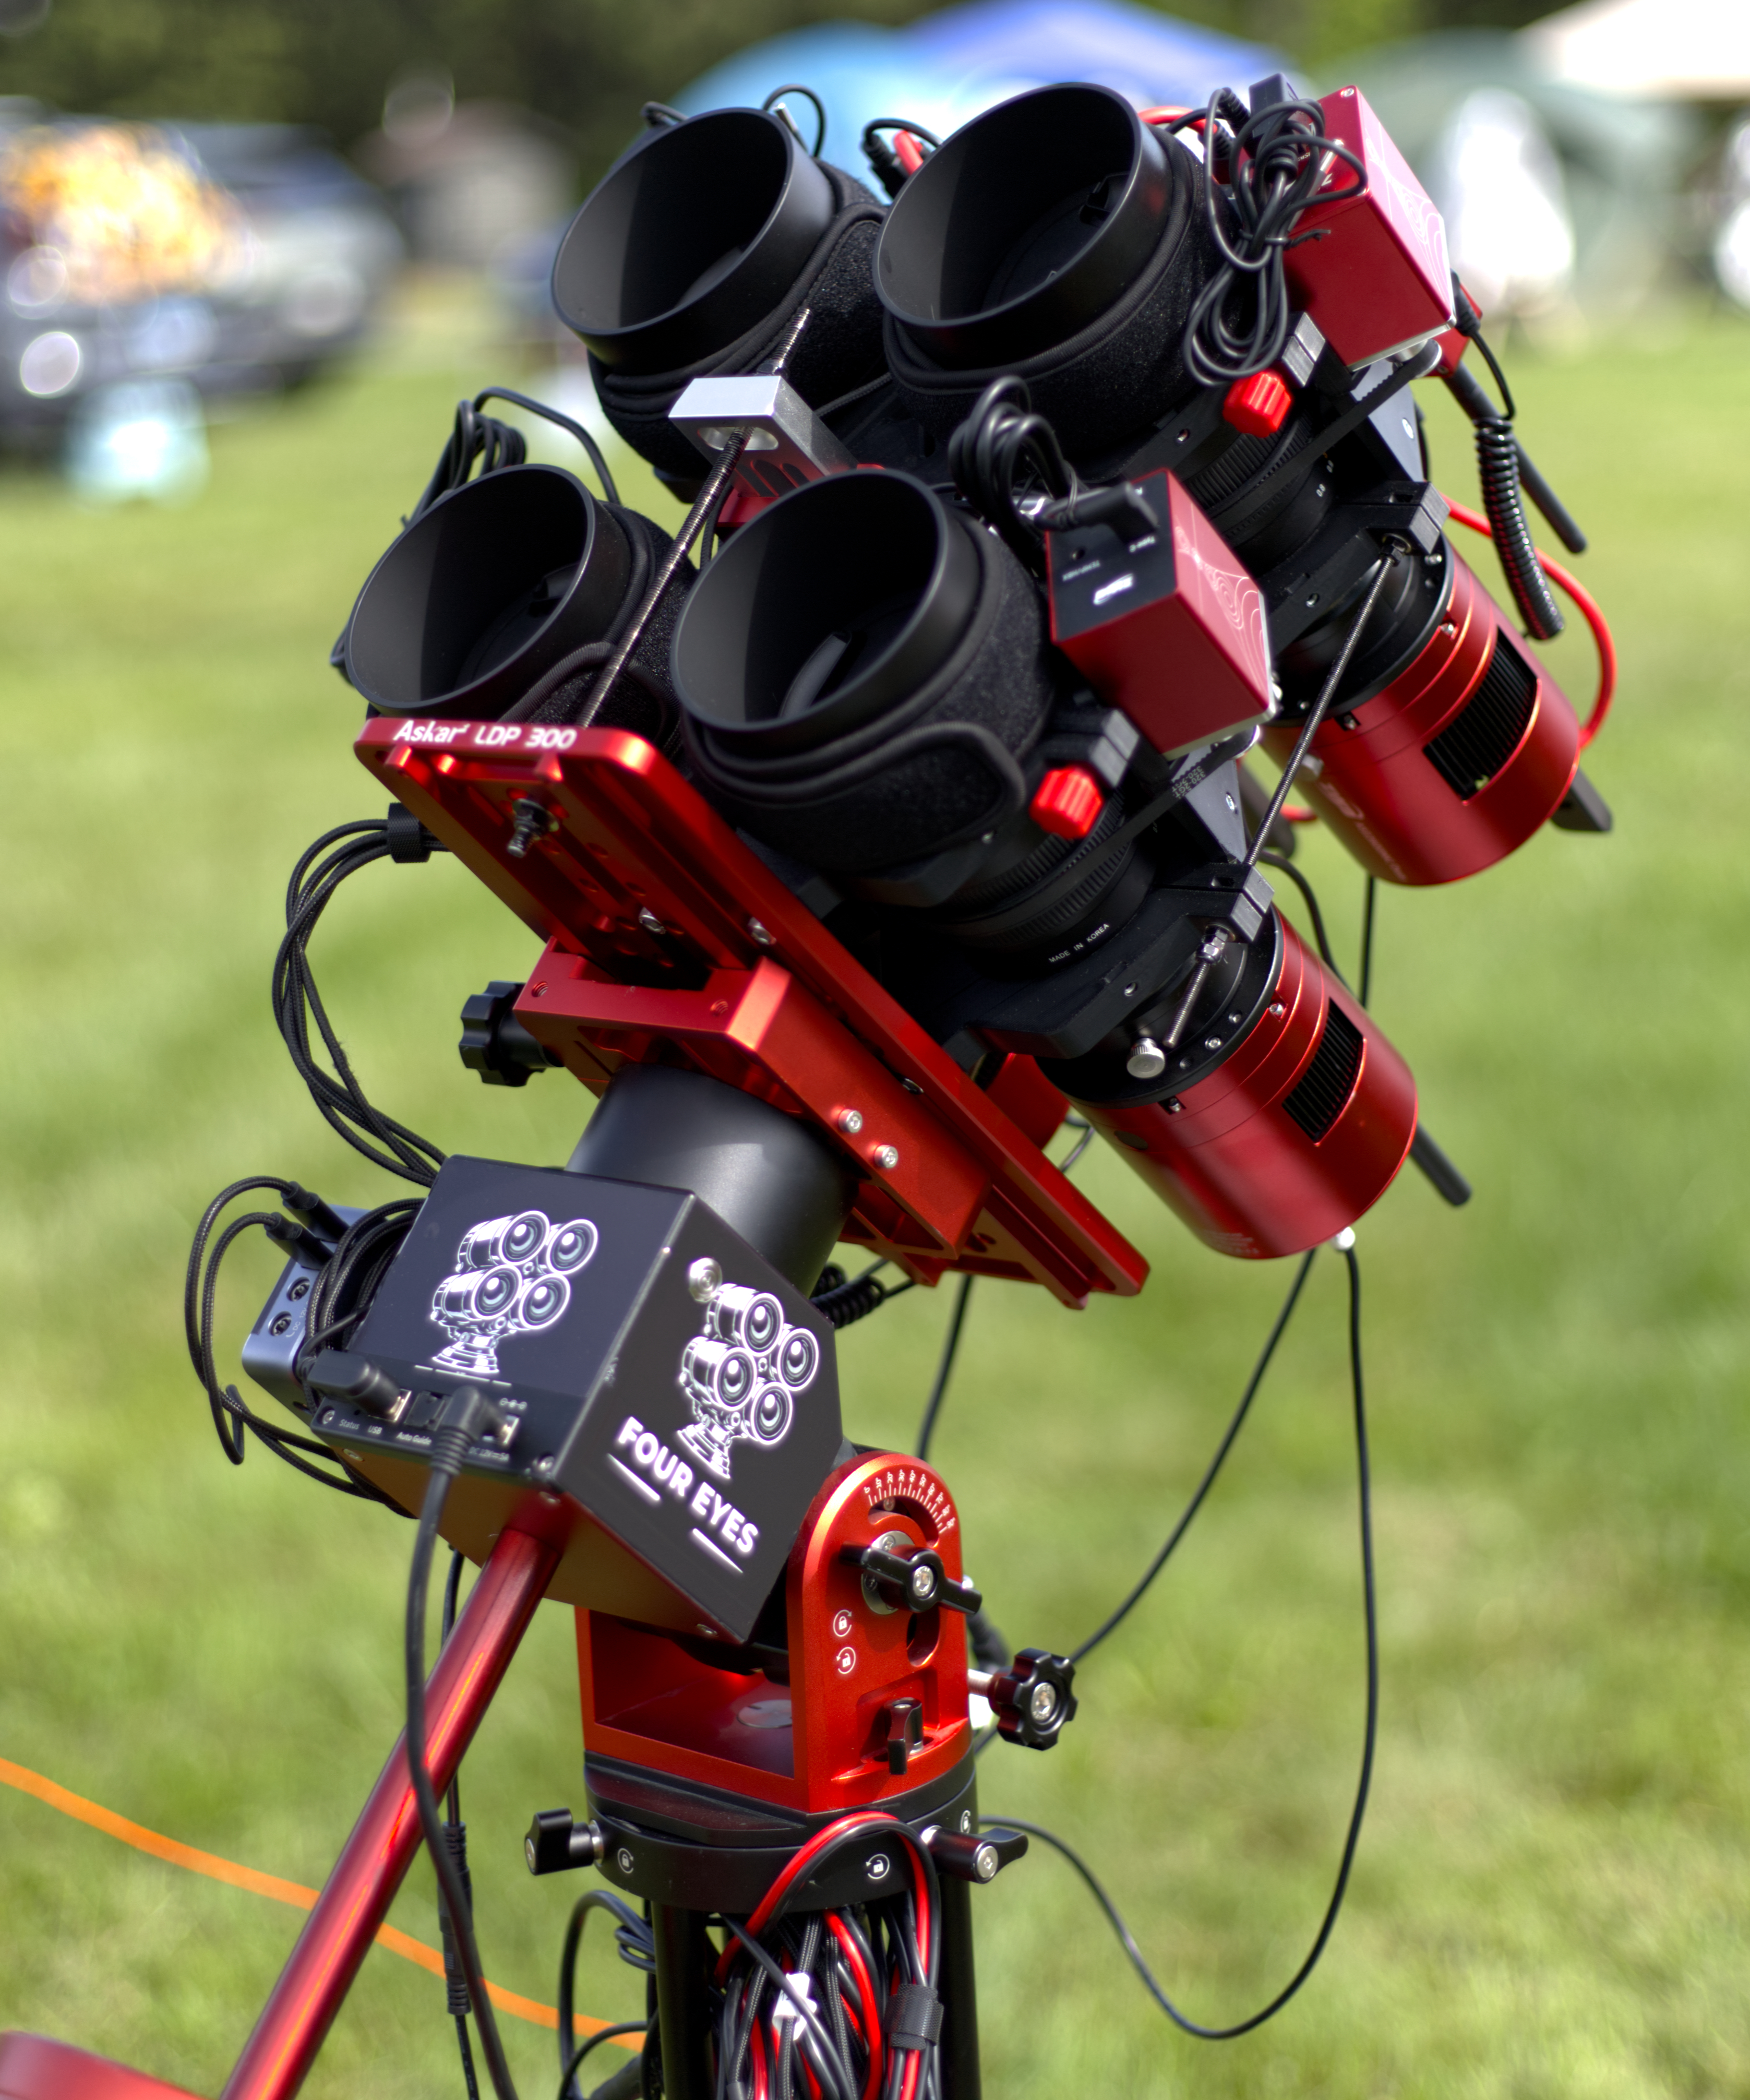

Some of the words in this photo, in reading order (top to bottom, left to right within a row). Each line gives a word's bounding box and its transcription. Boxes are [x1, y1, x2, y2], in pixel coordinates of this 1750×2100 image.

[393, 720, 470, 743] Askar
[474, 725, 522, 746] LDP
[524, 727, 577, 749] 300
[1048, 950, 1071, 963] MADE
[1073, 942, 1084, 951] IN
[1086, 923, 1109, 942] KOREA
[293, 1322, 301, 1331] DC
[340, 1419, 360, 1430] Status
[368, 1425, 383, 1435] USB
[396, 1431, 413, 1441] Auto
[412, 1435, 432, 1446] Guide
[618, 1416, 693, 1497] FOUR
[692, 1482, 759, 1553] EYES
